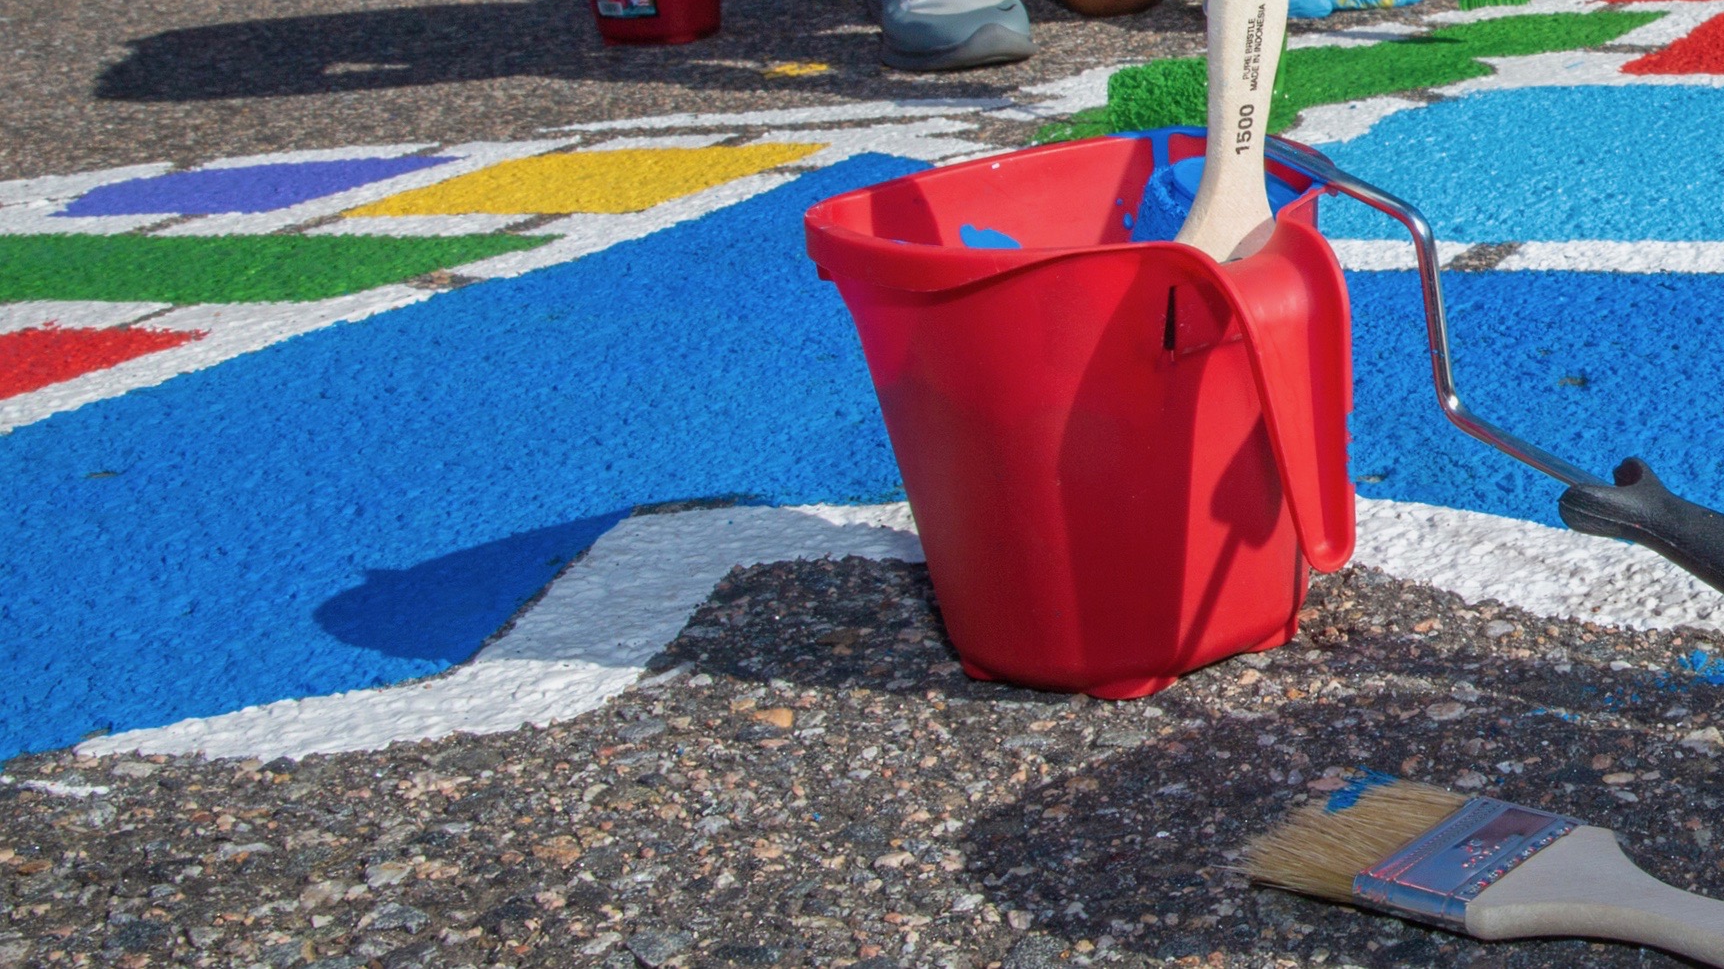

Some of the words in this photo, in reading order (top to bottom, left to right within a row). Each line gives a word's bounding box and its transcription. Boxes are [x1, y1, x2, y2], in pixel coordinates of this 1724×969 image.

[1245, 18, 1255, 53] BRISTLE
[1254, 3, 1266, 52] INDONESIA
[1243, 54, 1251, 80] PURE
[1253, 53, 1261, 64] IN
[1250, 64, 1259, 91] MADE
[1235, 103, 1255, 155] 1500
